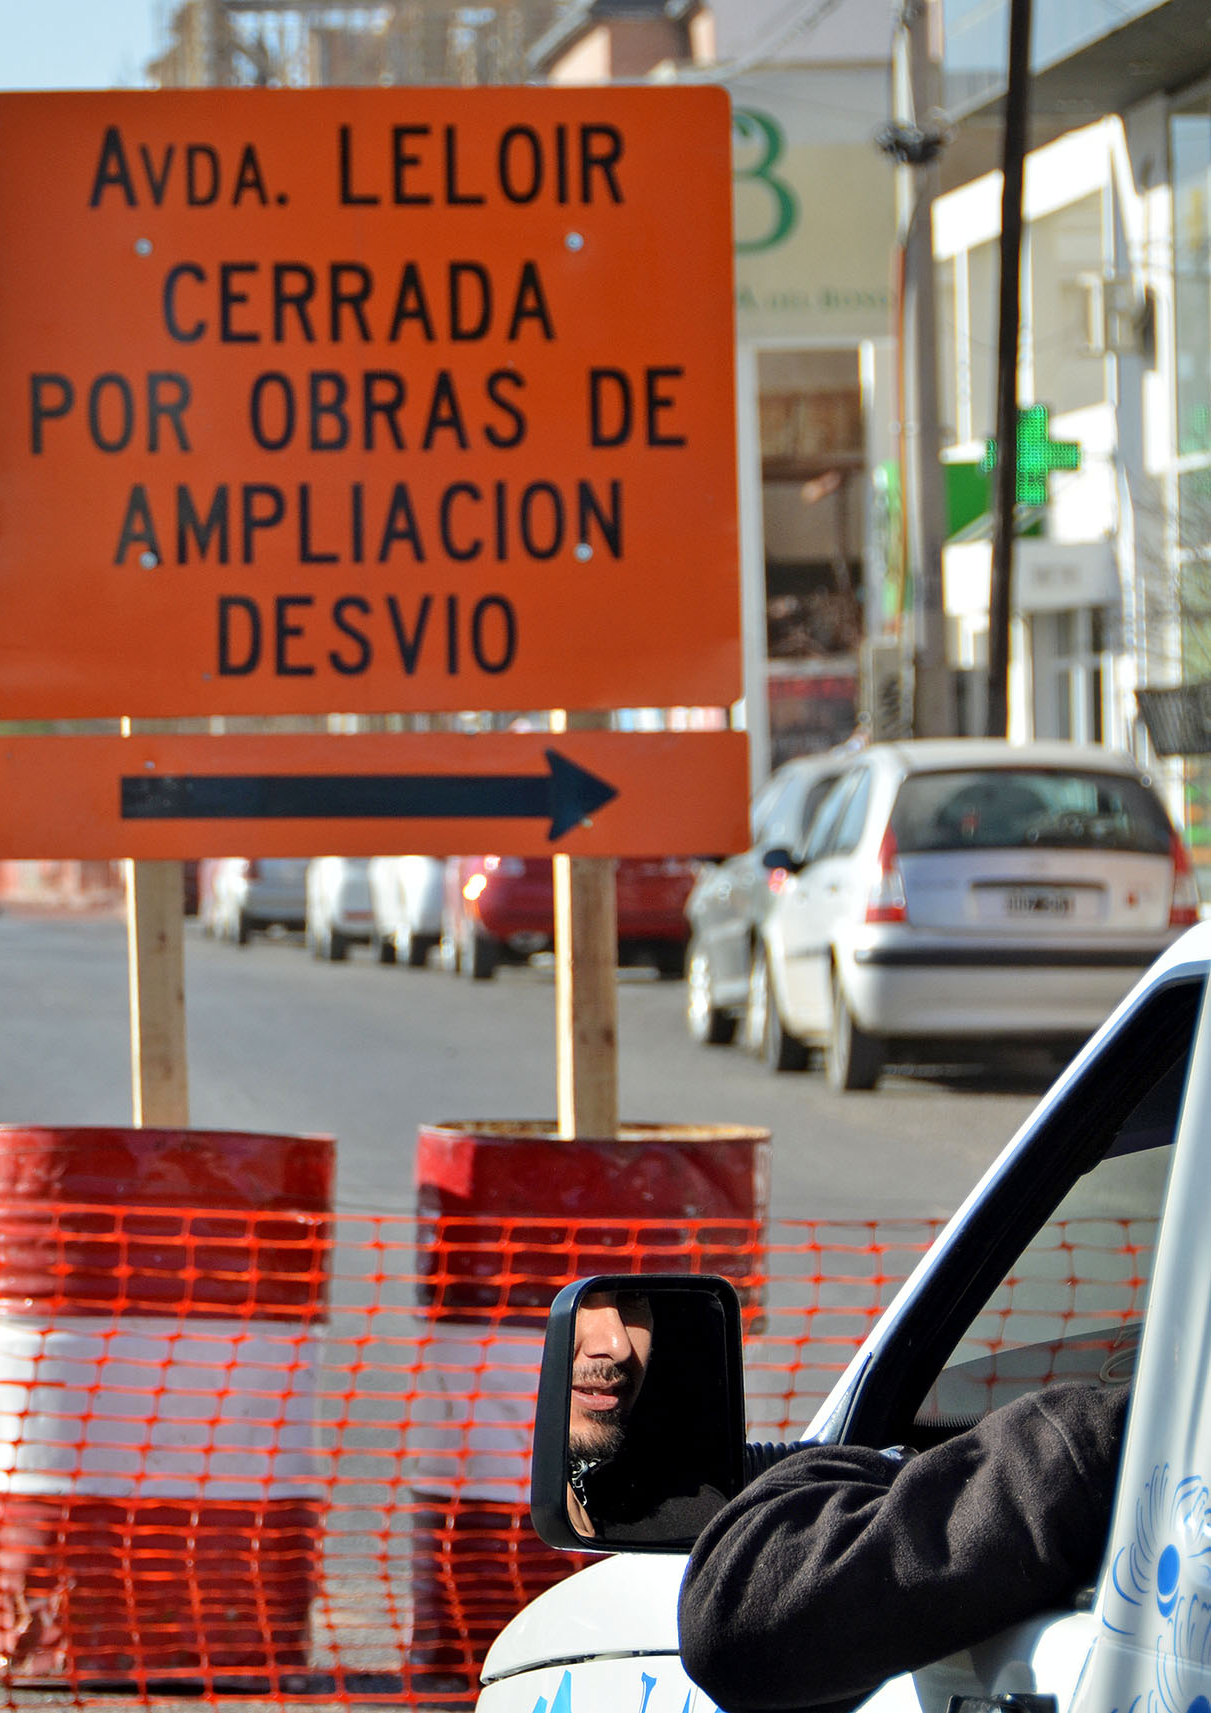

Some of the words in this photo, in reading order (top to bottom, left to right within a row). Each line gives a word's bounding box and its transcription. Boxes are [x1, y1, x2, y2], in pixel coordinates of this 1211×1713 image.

[339, 124, 623, 206] LELOIR
[163, 261, 554, 343] CERRADA
[30, 373, 190, 455] POR
[250, 369, 526, 451] OBRAS
[590, 366, 686, 448] DE
[115, 480, 622, 562] AMPLIACION
[218, 595, 517, 676] DESVIO
